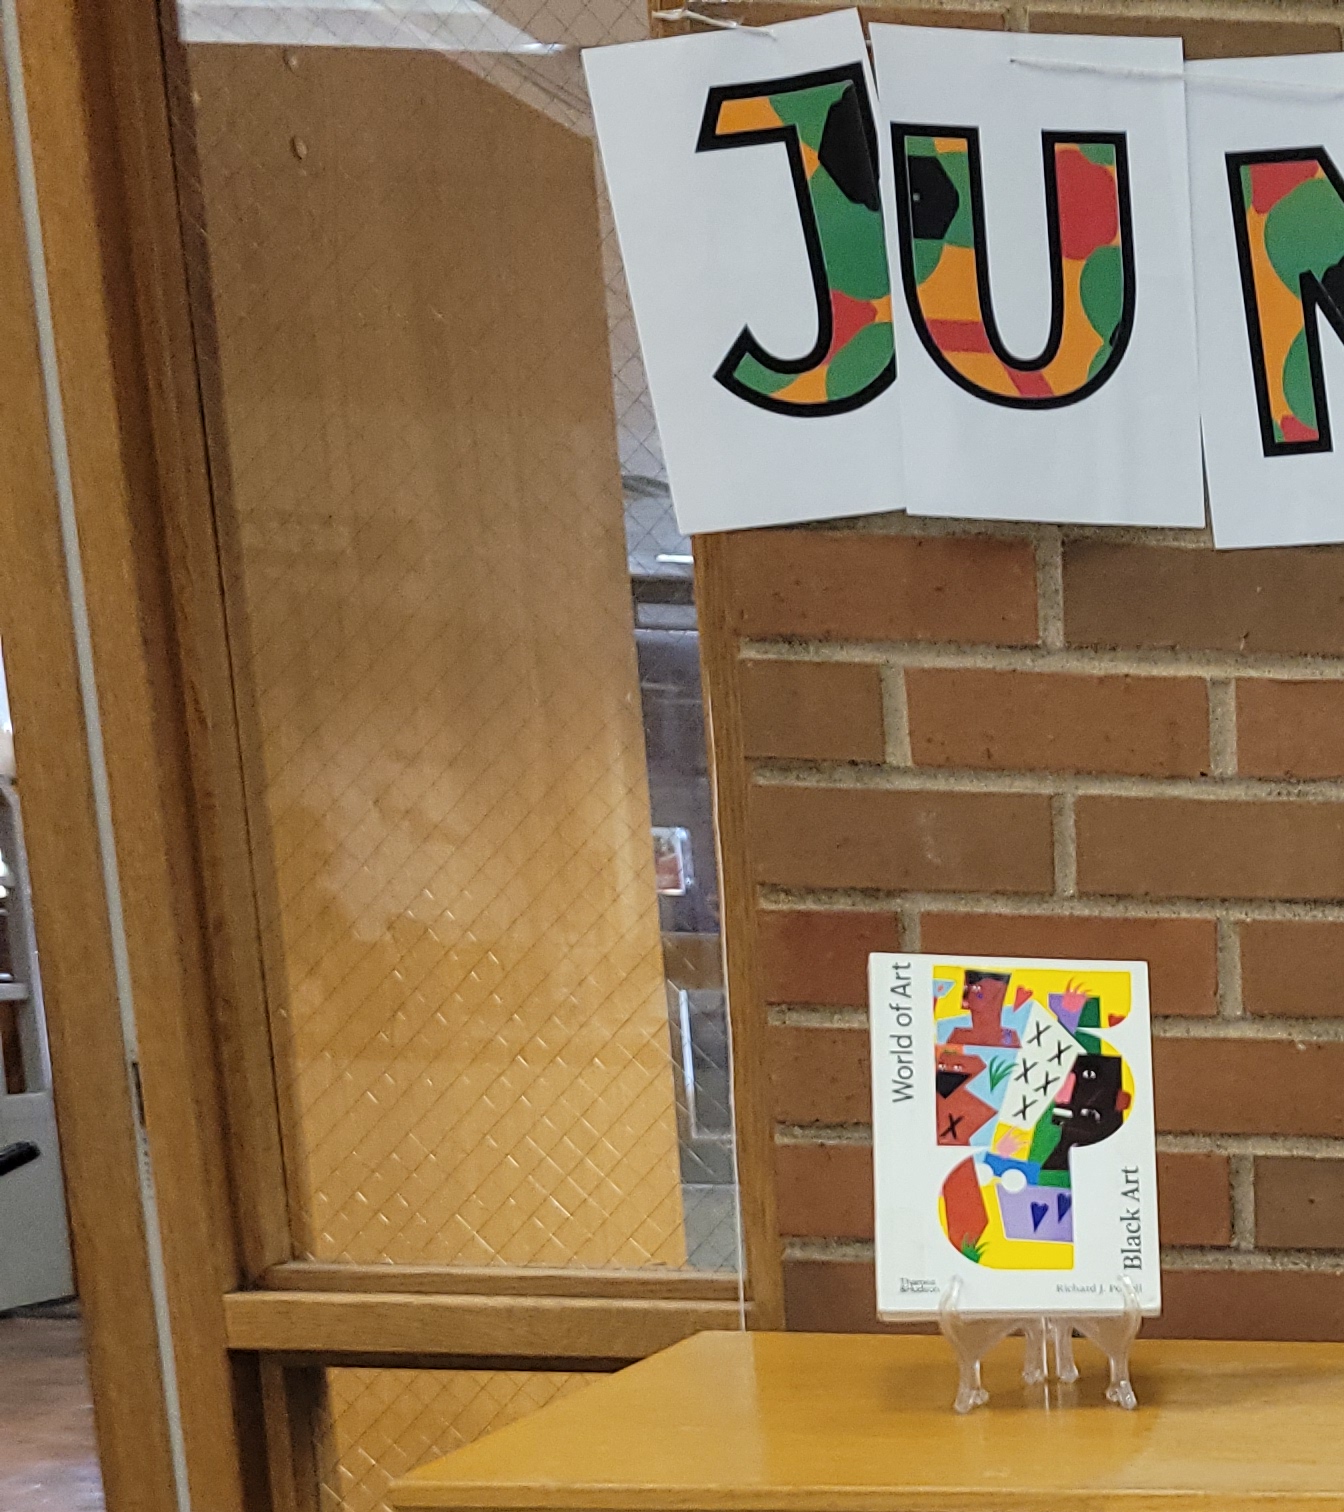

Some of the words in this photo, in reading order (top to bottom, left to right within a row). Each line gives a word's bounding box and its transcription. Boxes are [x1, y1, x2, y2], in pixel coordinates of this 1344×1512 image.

[890, 962, 912, 998] Art
[889, 1002, 912, 1026] of
[889, 1035, 914, 1102] World
[1121, 1165, 1141, 1202] Art
[1120, 1207, 1142, 1270] Black
